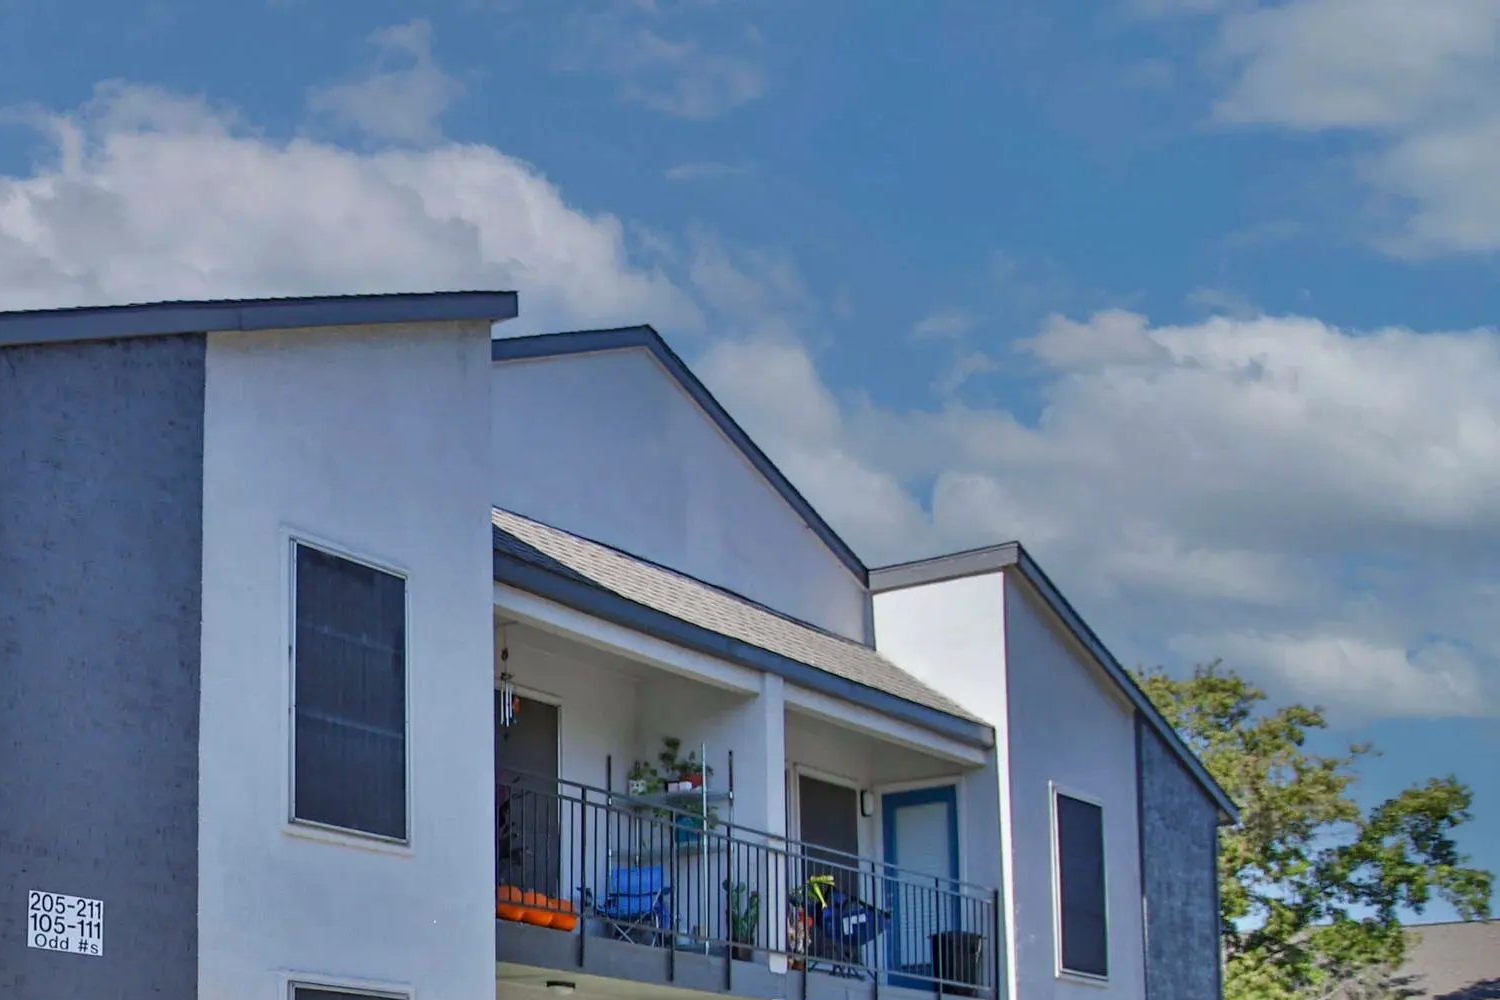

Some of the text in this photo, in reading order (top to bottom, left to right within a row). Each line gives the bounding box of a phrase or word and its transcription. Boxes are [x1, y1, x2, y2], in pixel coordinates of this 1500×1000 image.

[30, 892, 101, 919] 205-211
[30, 913, 101, 940] 105-111
[35, 933, 99, 955] Odd #s
